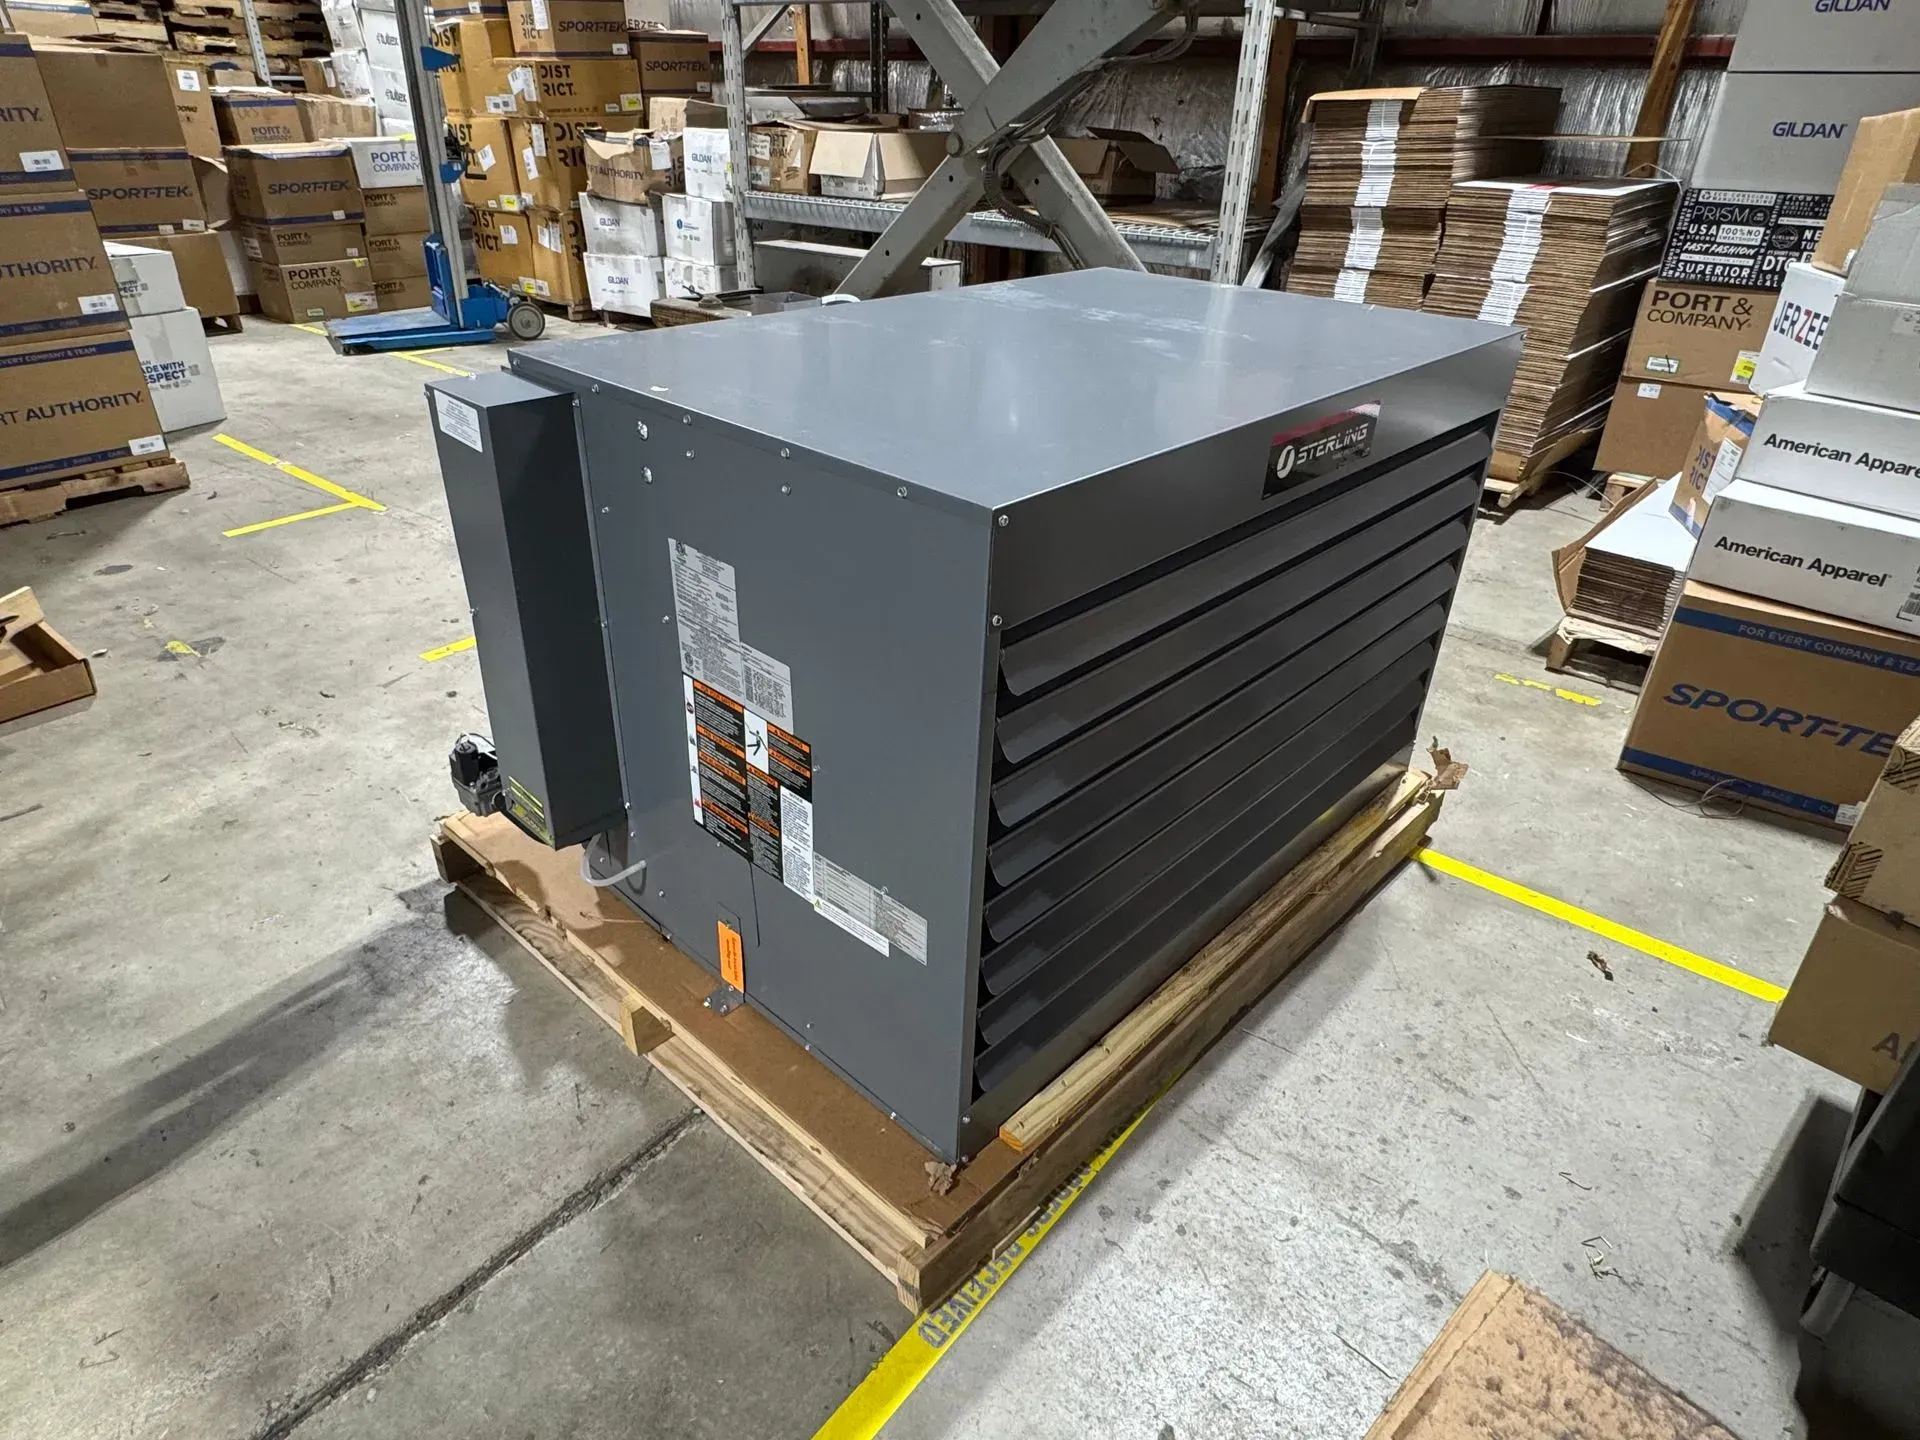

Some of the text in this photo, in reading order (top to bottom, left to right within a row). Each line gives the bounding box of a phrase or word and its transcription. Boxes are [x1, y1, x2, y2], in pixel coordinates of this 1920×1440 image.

[1815, 0, 1891, 12] GILDAN
[558, 21, 627, 33] SPORT-TEK
[540, 65, 571, 78] DIST
[645, 60, 707, 72] SPORT-TEK
[543, 83, 574, 96] RICT
[1772, 121, 1844, 139] GILDAN
[370, 151, 419, 164] PORT &
[373, 162, 421, 173] COMPANY
[87, 185, 189, 200] SPORT-TEK
[268, 180, 349, 195] SPORT-TEK
[364, 193, 387, 201] PORT
[1691, 205, 1750, 223] PRISM
[1689, 223, 1717, 236] USA
[1682, 241, 1758, 256] FAST FASHION
[0, 256, 96, 278] THORITY
[288, 266, 341, 280] PORT &
[1677, 262, 1750, 278] SUPERIOR
[291, 278, 342, 290] COMPANY
[1674, 271, 1747, 285] PRINT SURFACE
[1651, 290, 1754, 317] PORT &
[1647, 308, 1750, 331] COMPANY
[1773, 300, 1831, 351] JERZEE
[159, 361, 185, 372] WITH
[26, 391, 142, 422] AUTHORITY
[1296, 423, 1369, 465] STERLING
[1763, 433, 1852, 463] American
[1714, 535, 1888, 588] American Apparel
[1738, 623, 1765, 641] FOR
[1767, 630, 1812, 652] EVERY
[1814, 639, 1883, 666] COMPANY
[1662, 682, 1900, 758] SPORT-TE
